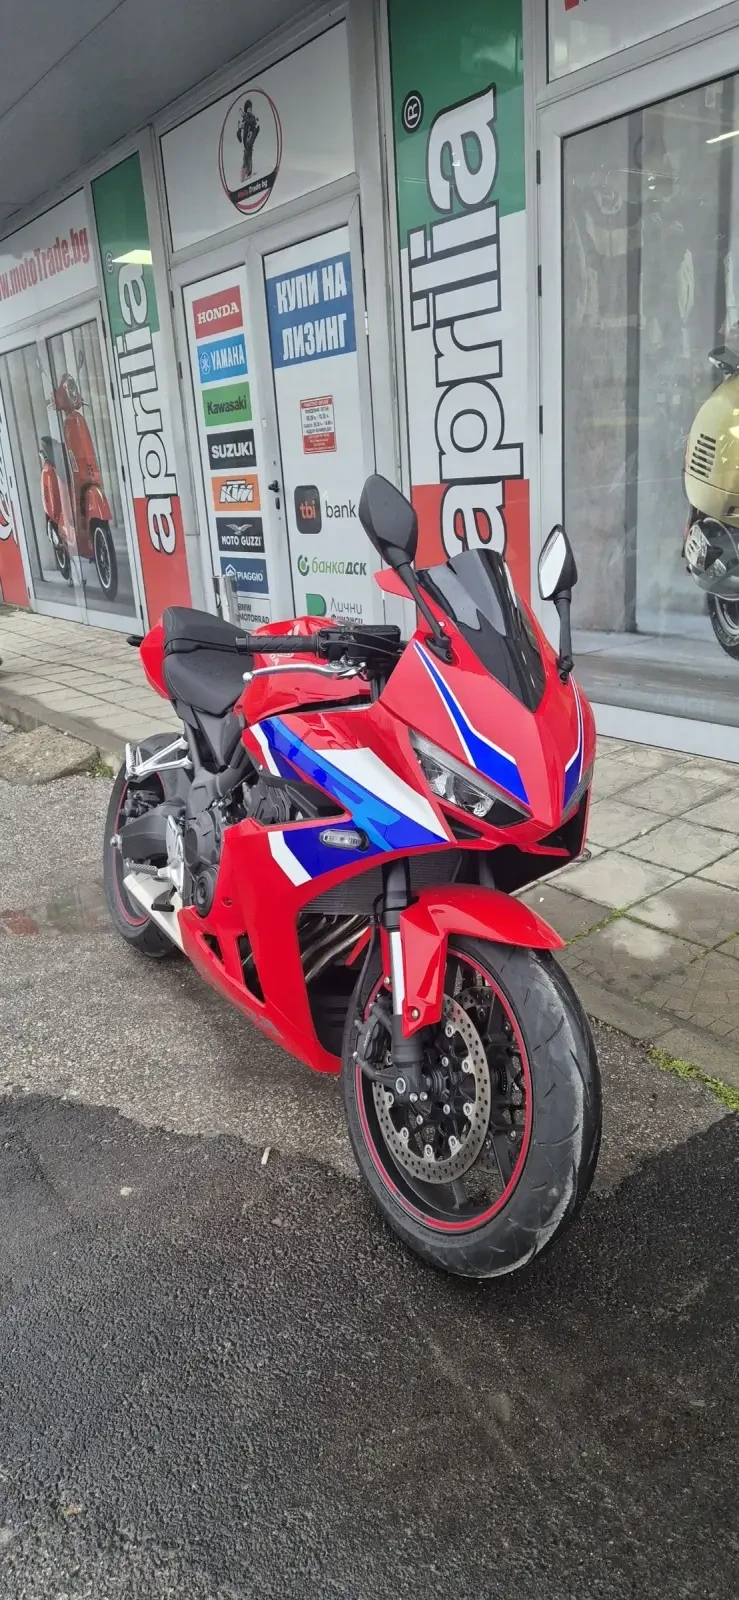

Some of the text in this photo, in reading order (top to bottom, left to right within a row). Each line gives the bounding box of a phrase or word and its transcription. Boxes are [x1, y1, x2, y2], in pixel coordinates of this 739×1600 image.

[276, 262, 347, 314] КУПИ НА
[197, 302, 240, 324] HONDA
[408, 83, 524, 560] aprilia
[282, 313, 347, 360] ЛИЗИНГ
[210, 344, 245, 371] YAMAHA
[115, 262, 178, 555] aprilia
[207, 395, 247, 415] Kawasaki
[211, 441, 254, 459] SUZUKI
[219, 479, 254, 503] KTM
[300, 500, 358, 519] tbi bank
[221, 535, 262, 547] MOTO GUZZI
[236, 571, 264, 582] PIAGGIO
[237, 603, 252, 612] BMW
[330, 596, 363, 615] Лични
